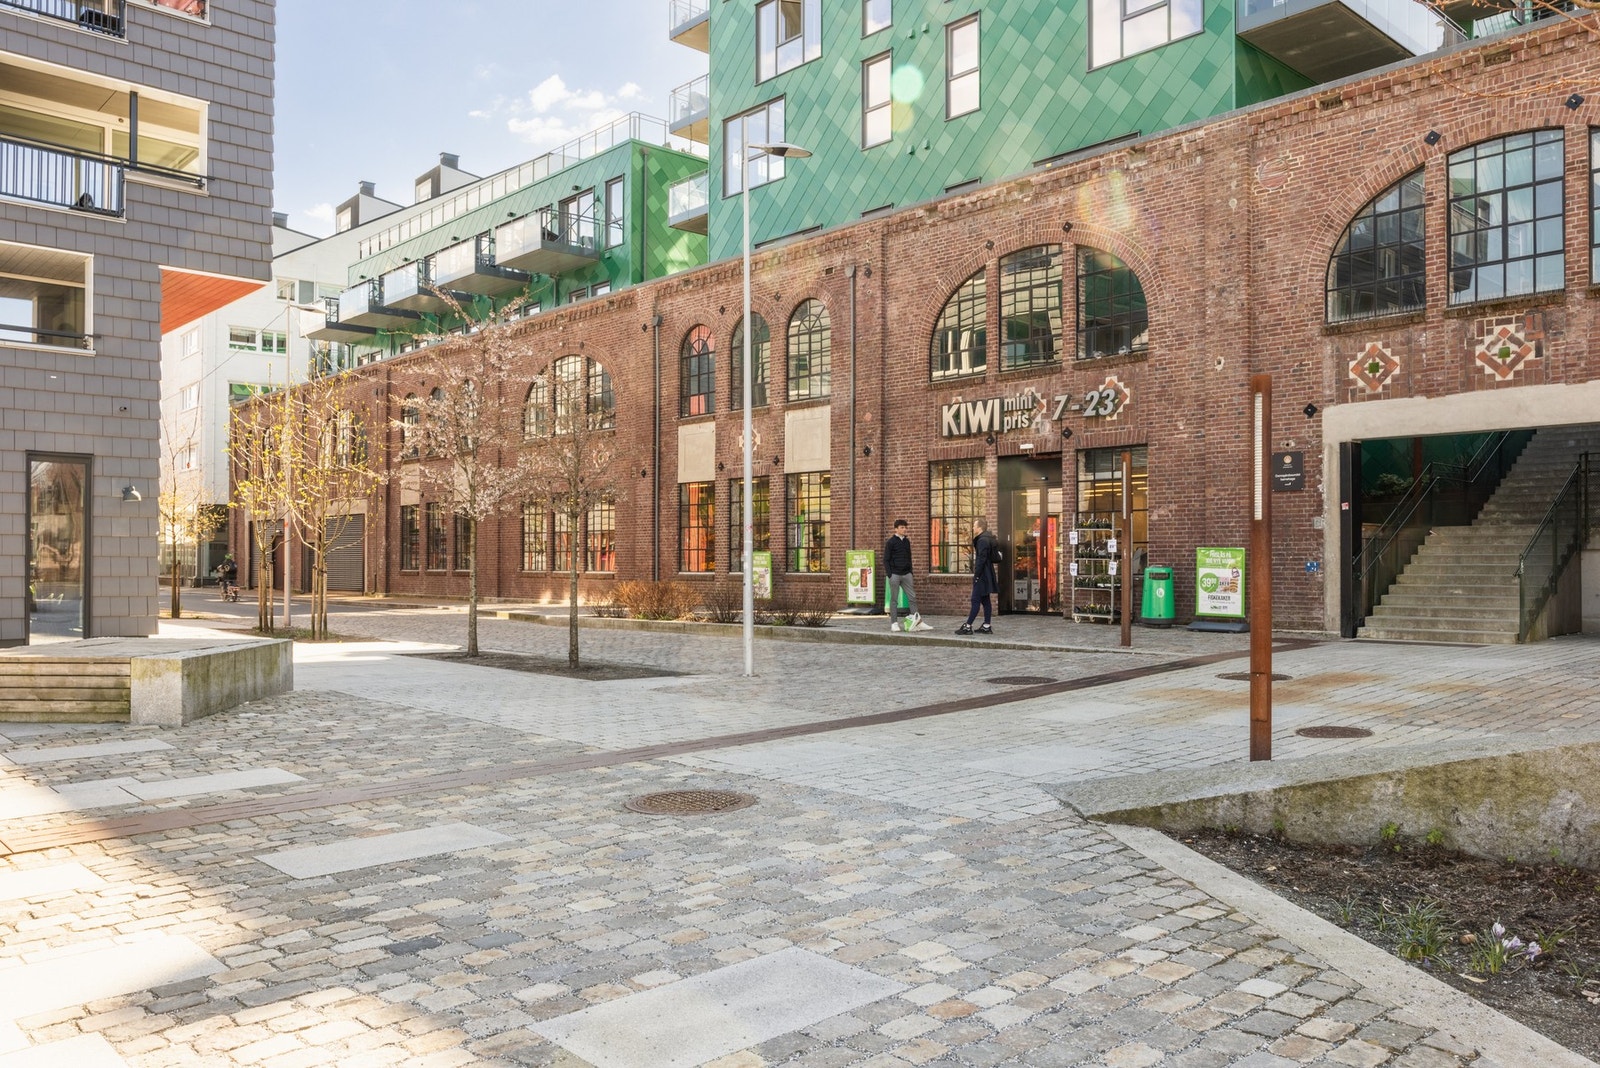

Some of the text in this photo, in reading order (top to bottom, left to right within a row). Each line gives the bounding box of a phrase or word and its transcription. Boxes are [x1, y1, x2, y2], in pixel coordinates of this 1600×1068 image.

[1003, 393, 1033, 412] mini
[942, 398, 1001, 437] KIWI
[1003, 411, 1030, 434] pris
